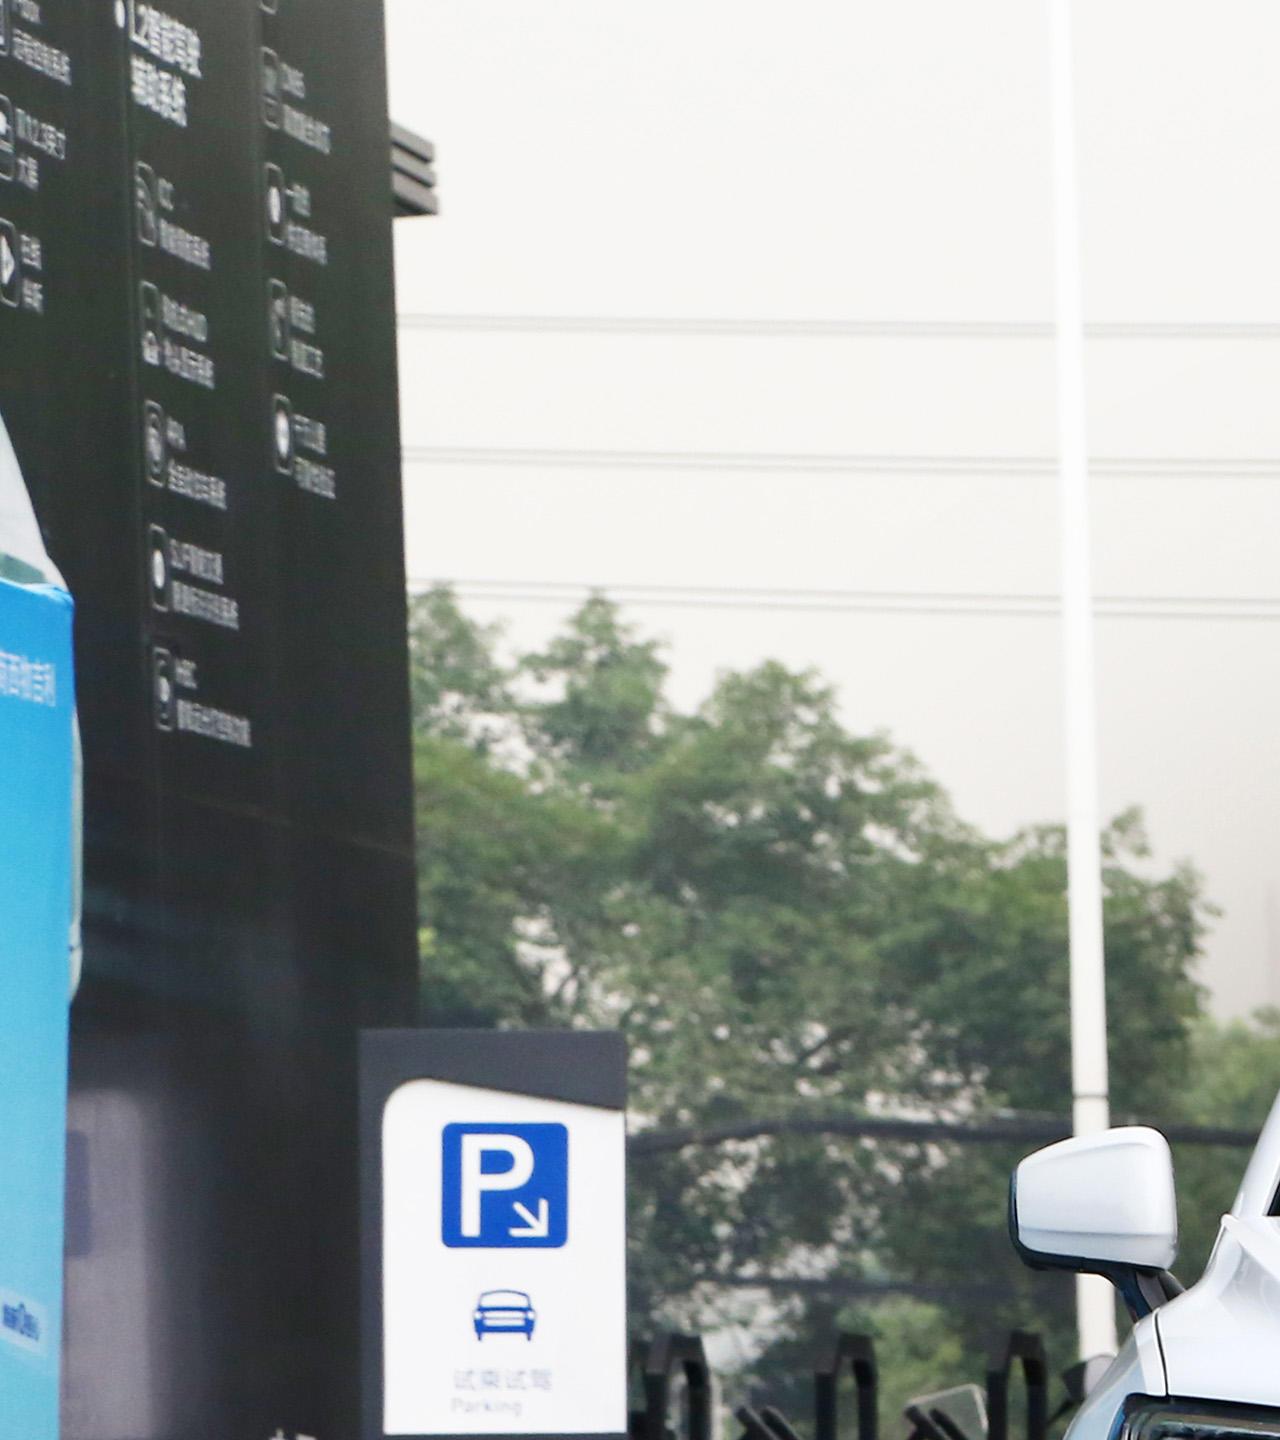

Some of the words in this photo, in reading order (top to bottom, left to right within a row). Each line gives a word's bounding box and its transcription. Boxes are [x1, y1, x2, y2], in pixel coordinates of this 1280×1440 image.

[461, 1134, 535, 1238] P
[454, 1367, 553, 1391] 试乘试驾
[450, 1397, 522, 1417] Parking
